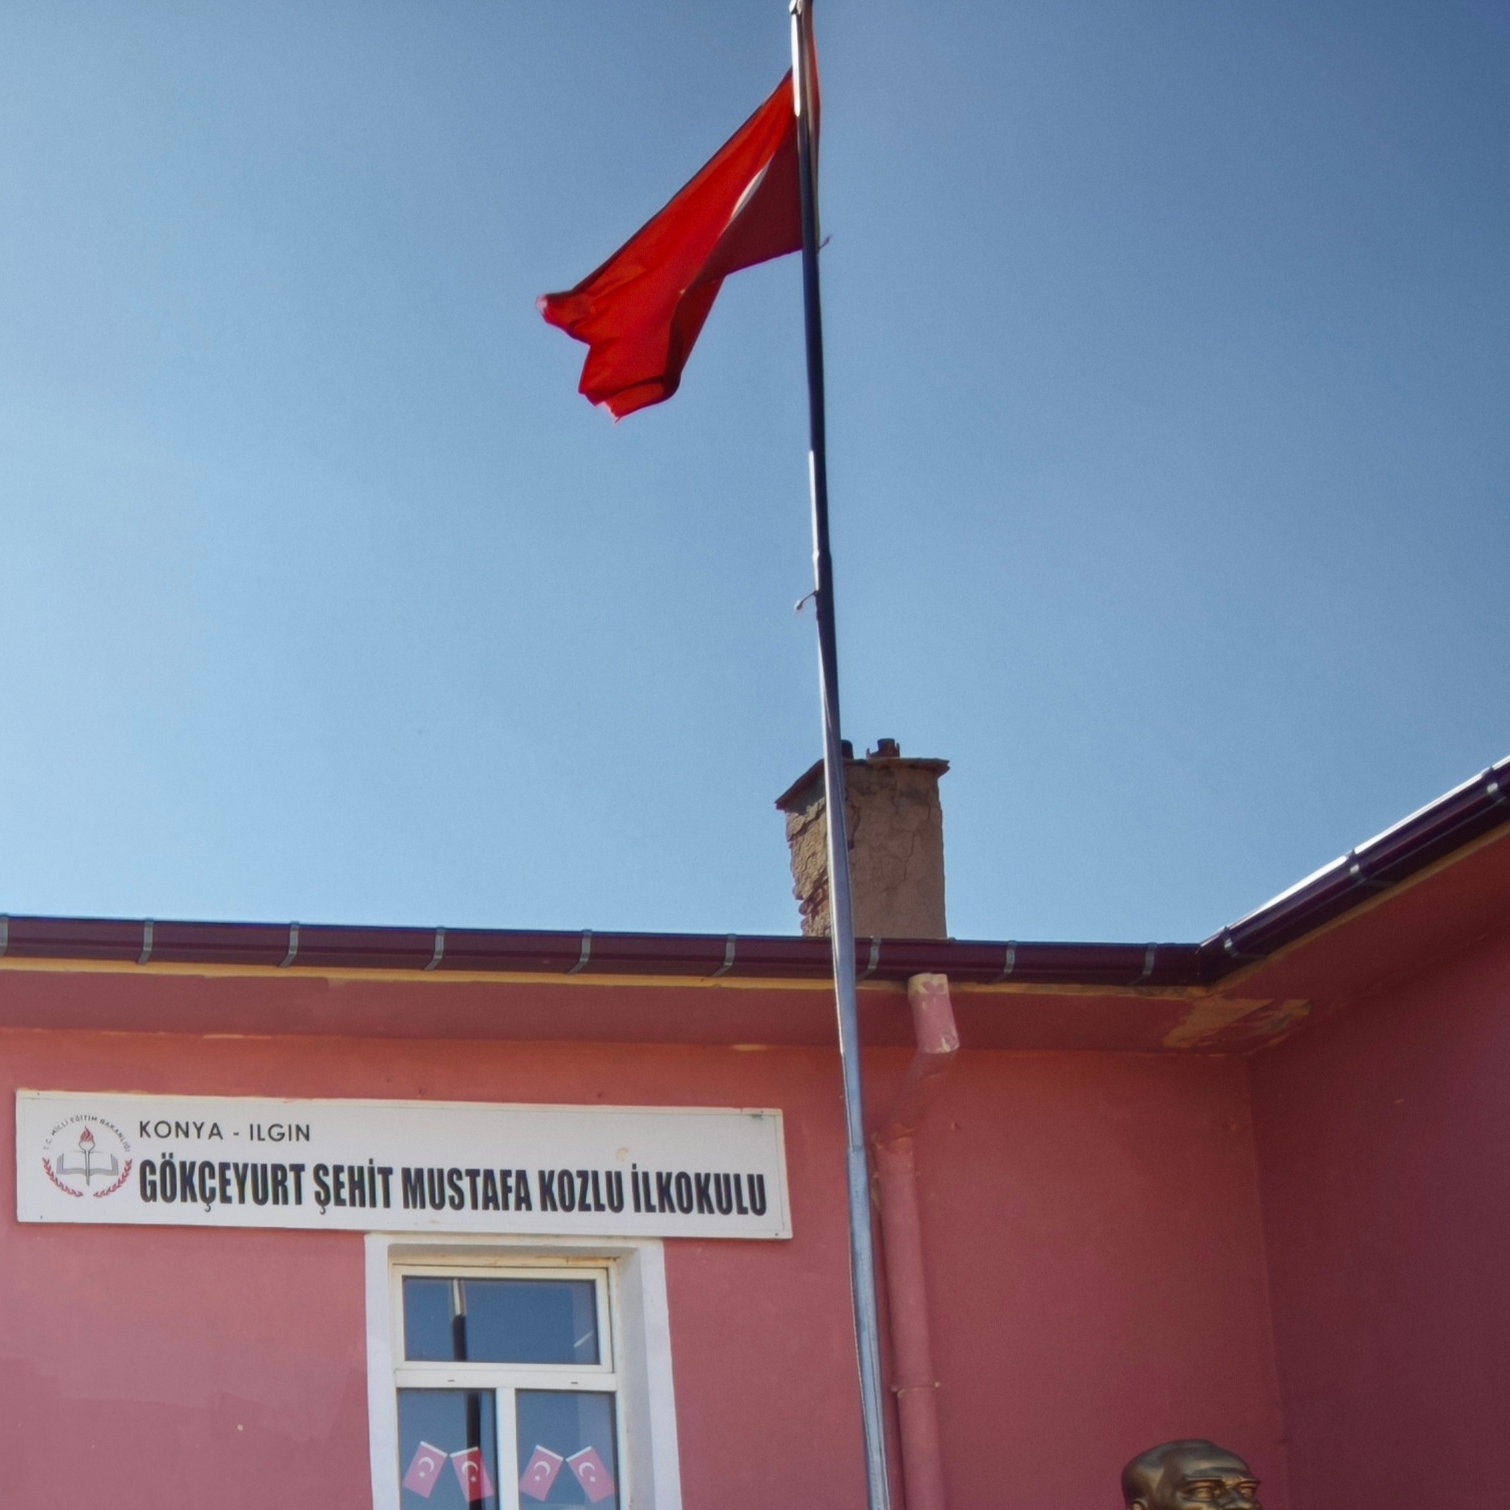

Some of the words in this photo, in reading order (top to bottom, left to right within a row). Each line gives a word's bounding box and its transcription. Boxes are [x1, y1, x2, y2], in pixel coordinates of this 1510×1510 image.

[138, 1120, 224, 1141] KONYA
[249, 1123, 311, 1142] ILGIN
[139, 1152, 305, 1213] GÖKÇEYURT
[312, 1158, 394, 1215] ŞEHİT
[401, 1166, 533, 1212] MUSTAFA
[538, 1168, 625, 1214] KOZLU
[631, 1162, 767, 1216] İLKOKULU
